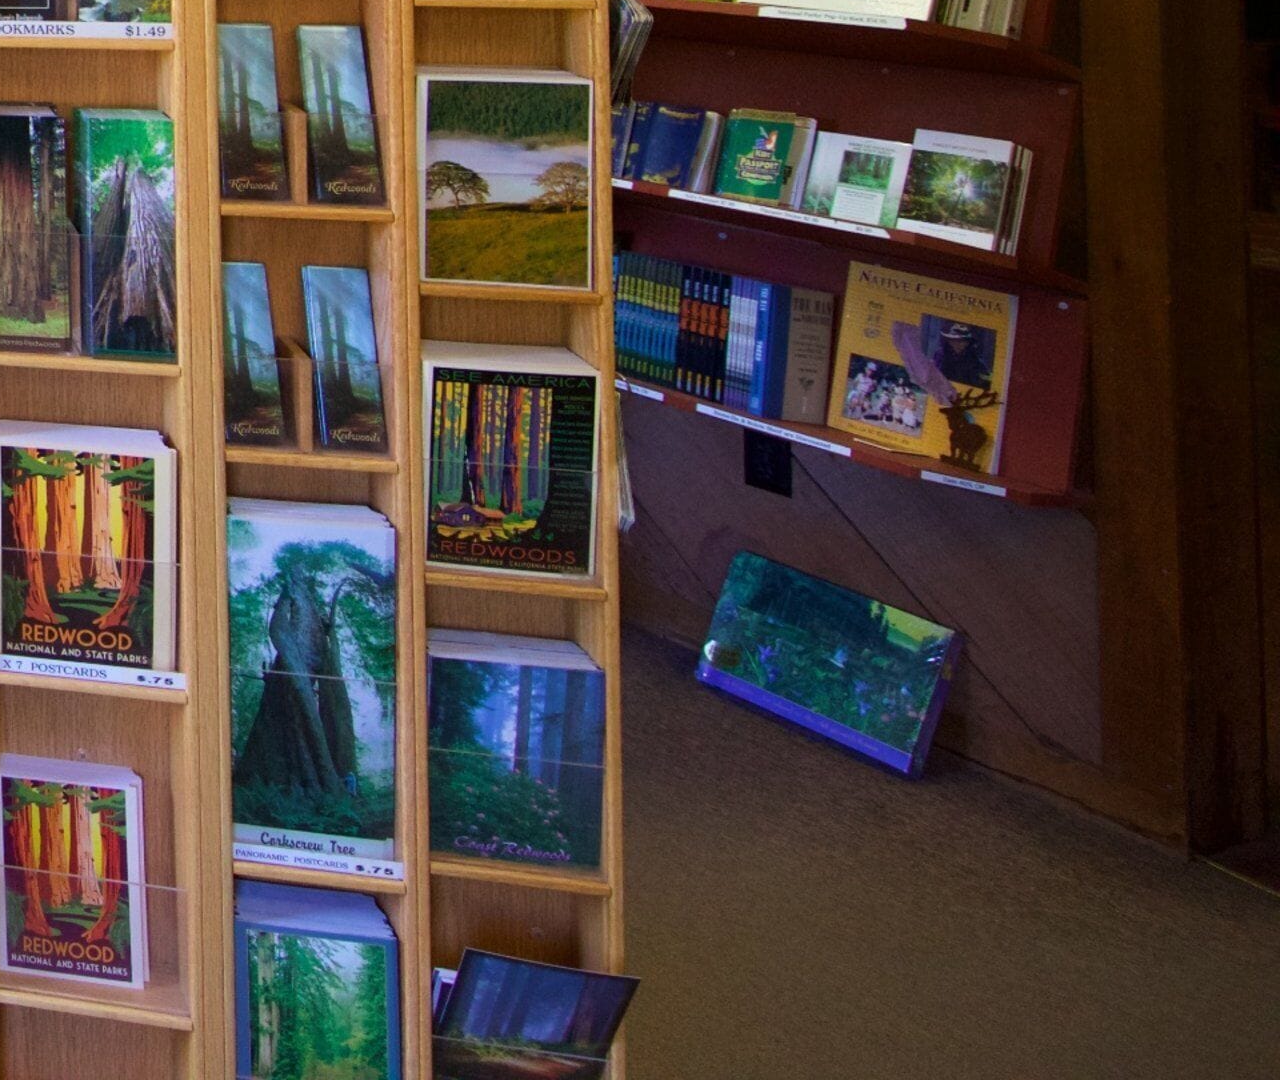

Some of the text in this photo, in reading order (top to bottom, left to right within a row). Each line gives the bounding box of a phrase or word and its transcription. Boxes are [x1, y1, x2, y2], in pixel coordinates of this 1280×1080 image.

[125, 25, 167, 37] $1.49
[228, 177, 279, 193] Redwoods
[325, 180, 377, 195] Redwoods
[858, 270, 911, 293] NATIVE
[915, 282, 1003, 314] CALIFORNIA
[438, 369, 590, 389] SEE AMERICA
[230, 421, 280, 437] Redwoods
[330, 428, 381, 444] Redwoods
[440, 539, 577, 565] REDWOODS
[21, 623, 133, 651] REDWOOD
[6, 641, 149, 665] NATIONAL AND STATE PARKS
[3, 659, 12, 669] X
[15, 660, 23, 670] 7
[31, 662, 108, 679] POSTCARDS
[136, 674, 175, 686] $.75
[260, 831, 357, 856] Corkscrew Tree
[454, 835, 572, 862] Coast Redwoods
[235, 847, 395, 876] PANORAMIC POSTCARDS $.75
[22, 935, 115, 964] REDWOOD
[11, 953, 128, 977] NATIONAL AND STATE PARKS
